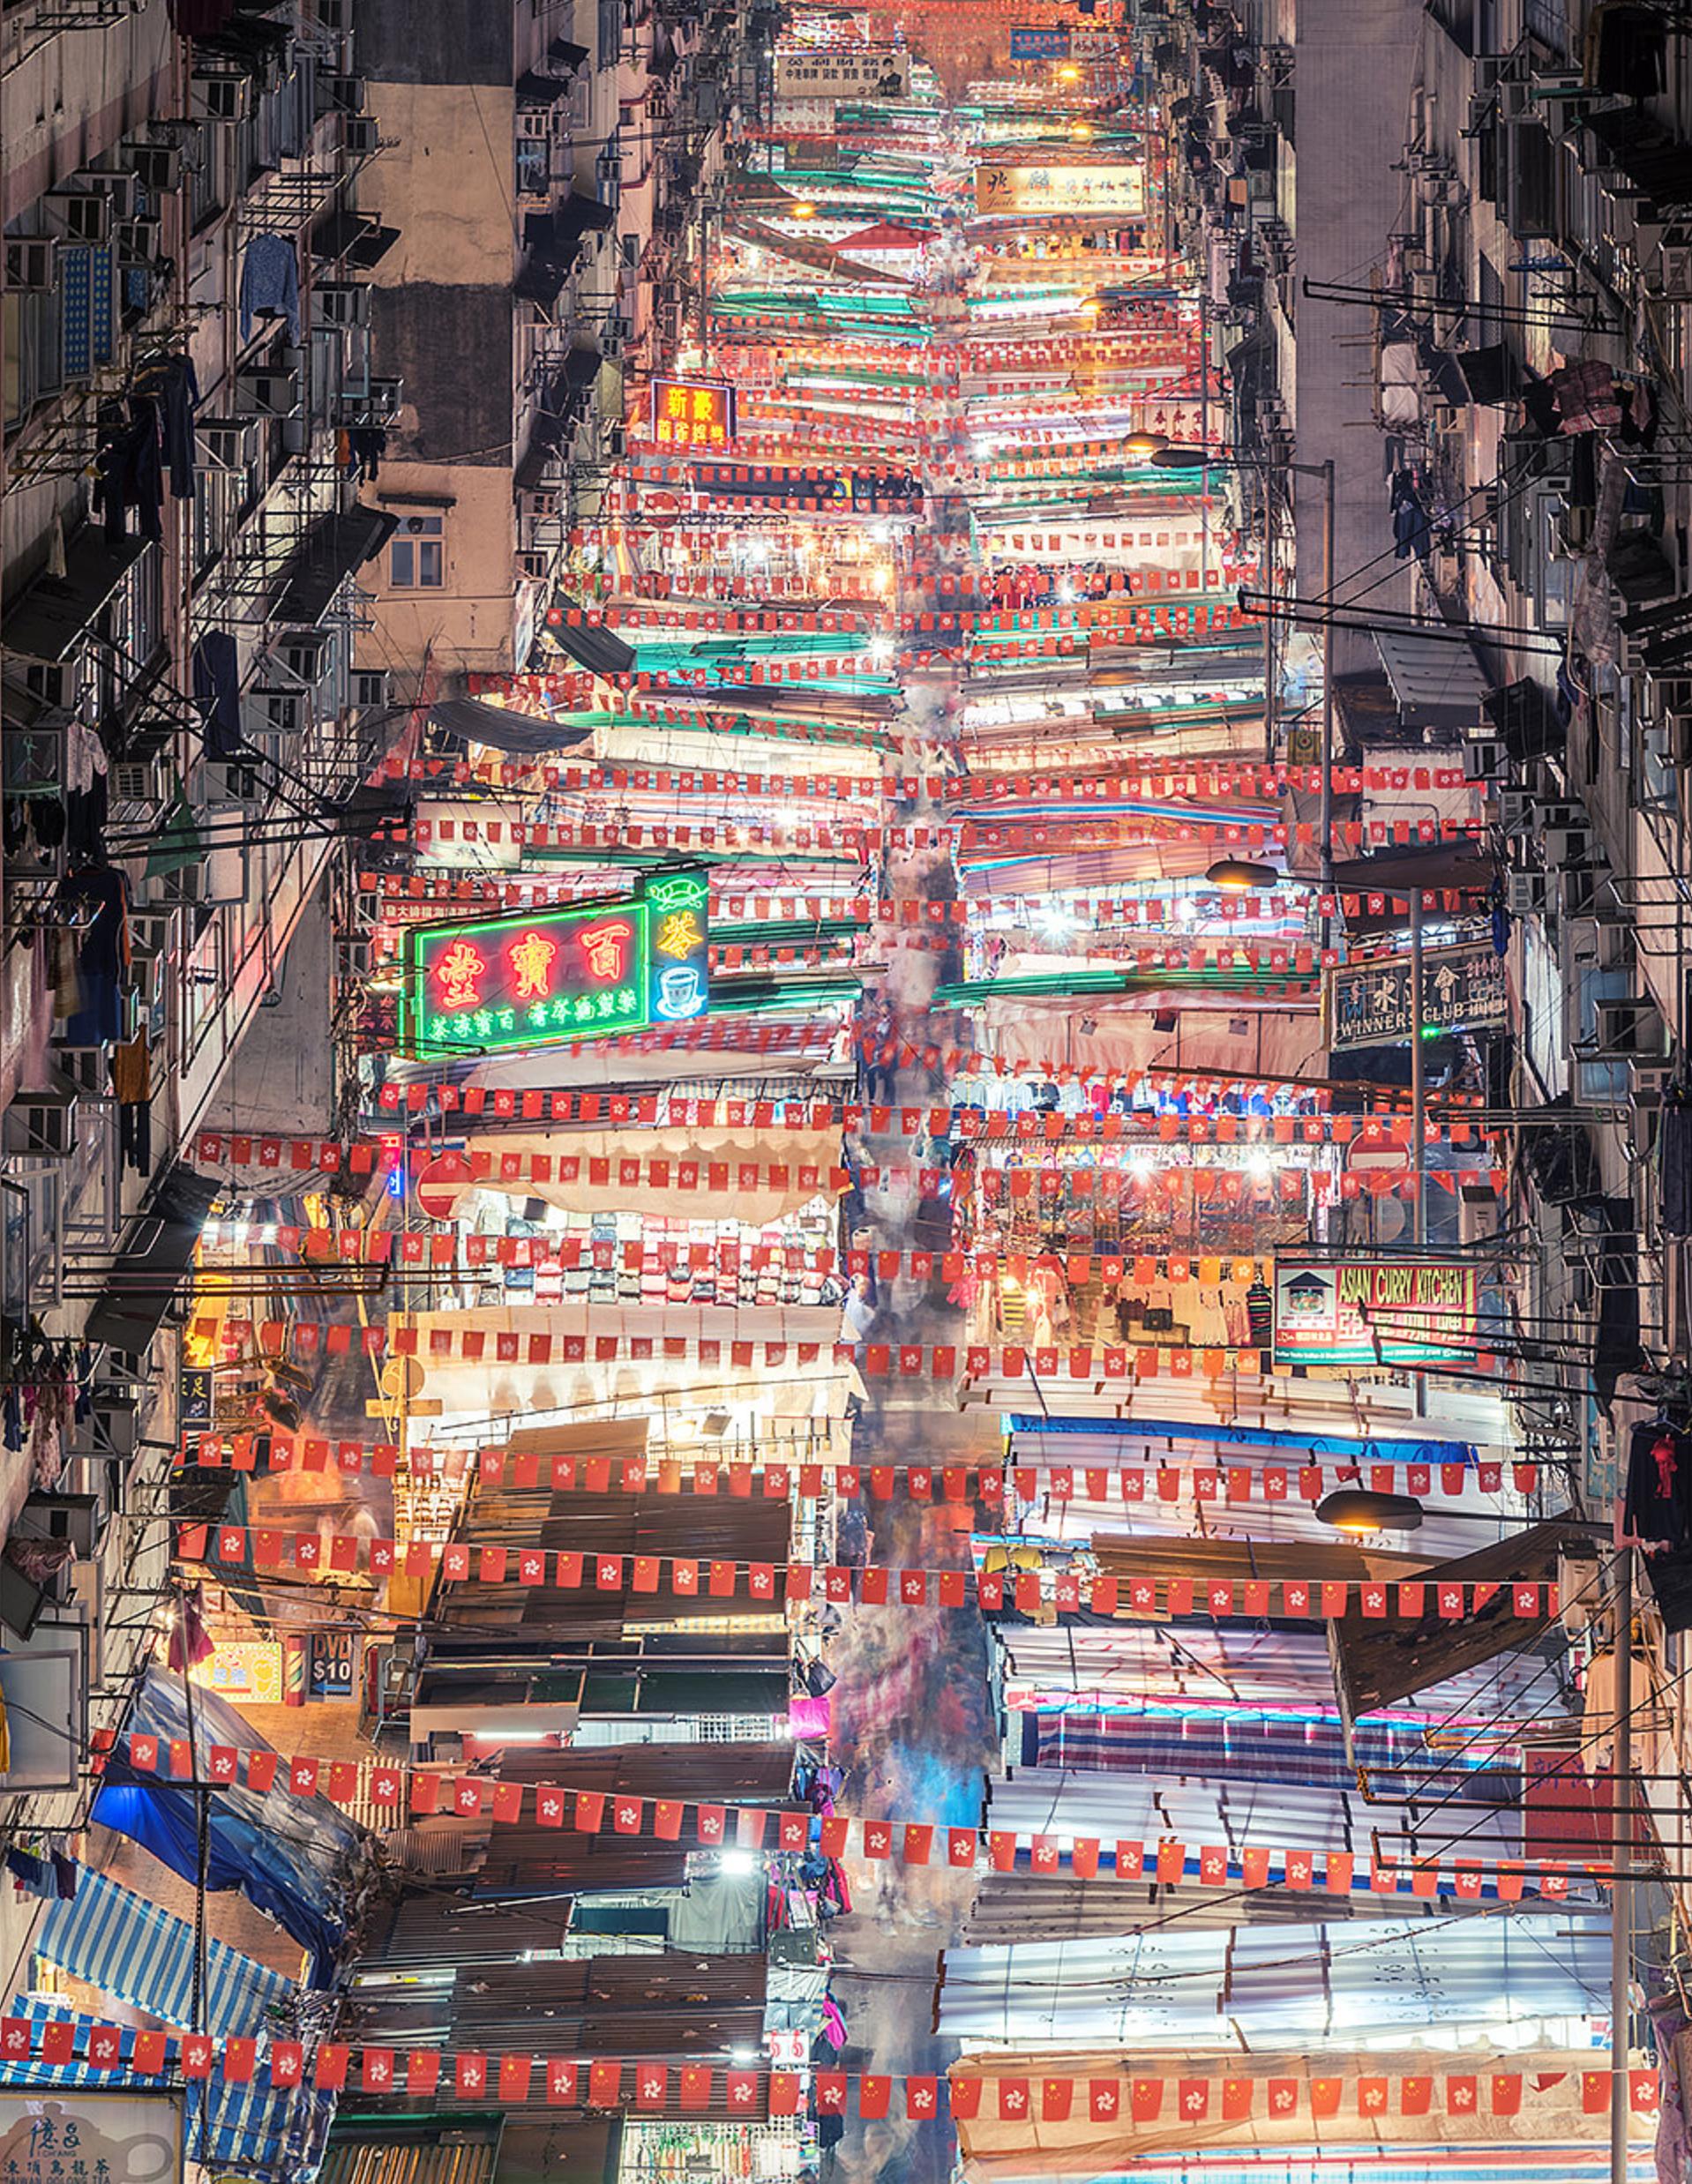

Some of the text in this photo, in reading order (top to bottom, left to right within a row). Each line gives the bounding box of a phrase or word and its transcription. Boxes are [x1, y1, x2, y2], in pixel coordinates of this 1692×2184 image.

[1422, 1002, 1464, 1024] CLUB
[1339, 1268, 1463, 1305] ASIAN CURRY KITCHEN
[315, 1634, 351, 1660] DVD
[313, 1662, 351, 1682] $10
